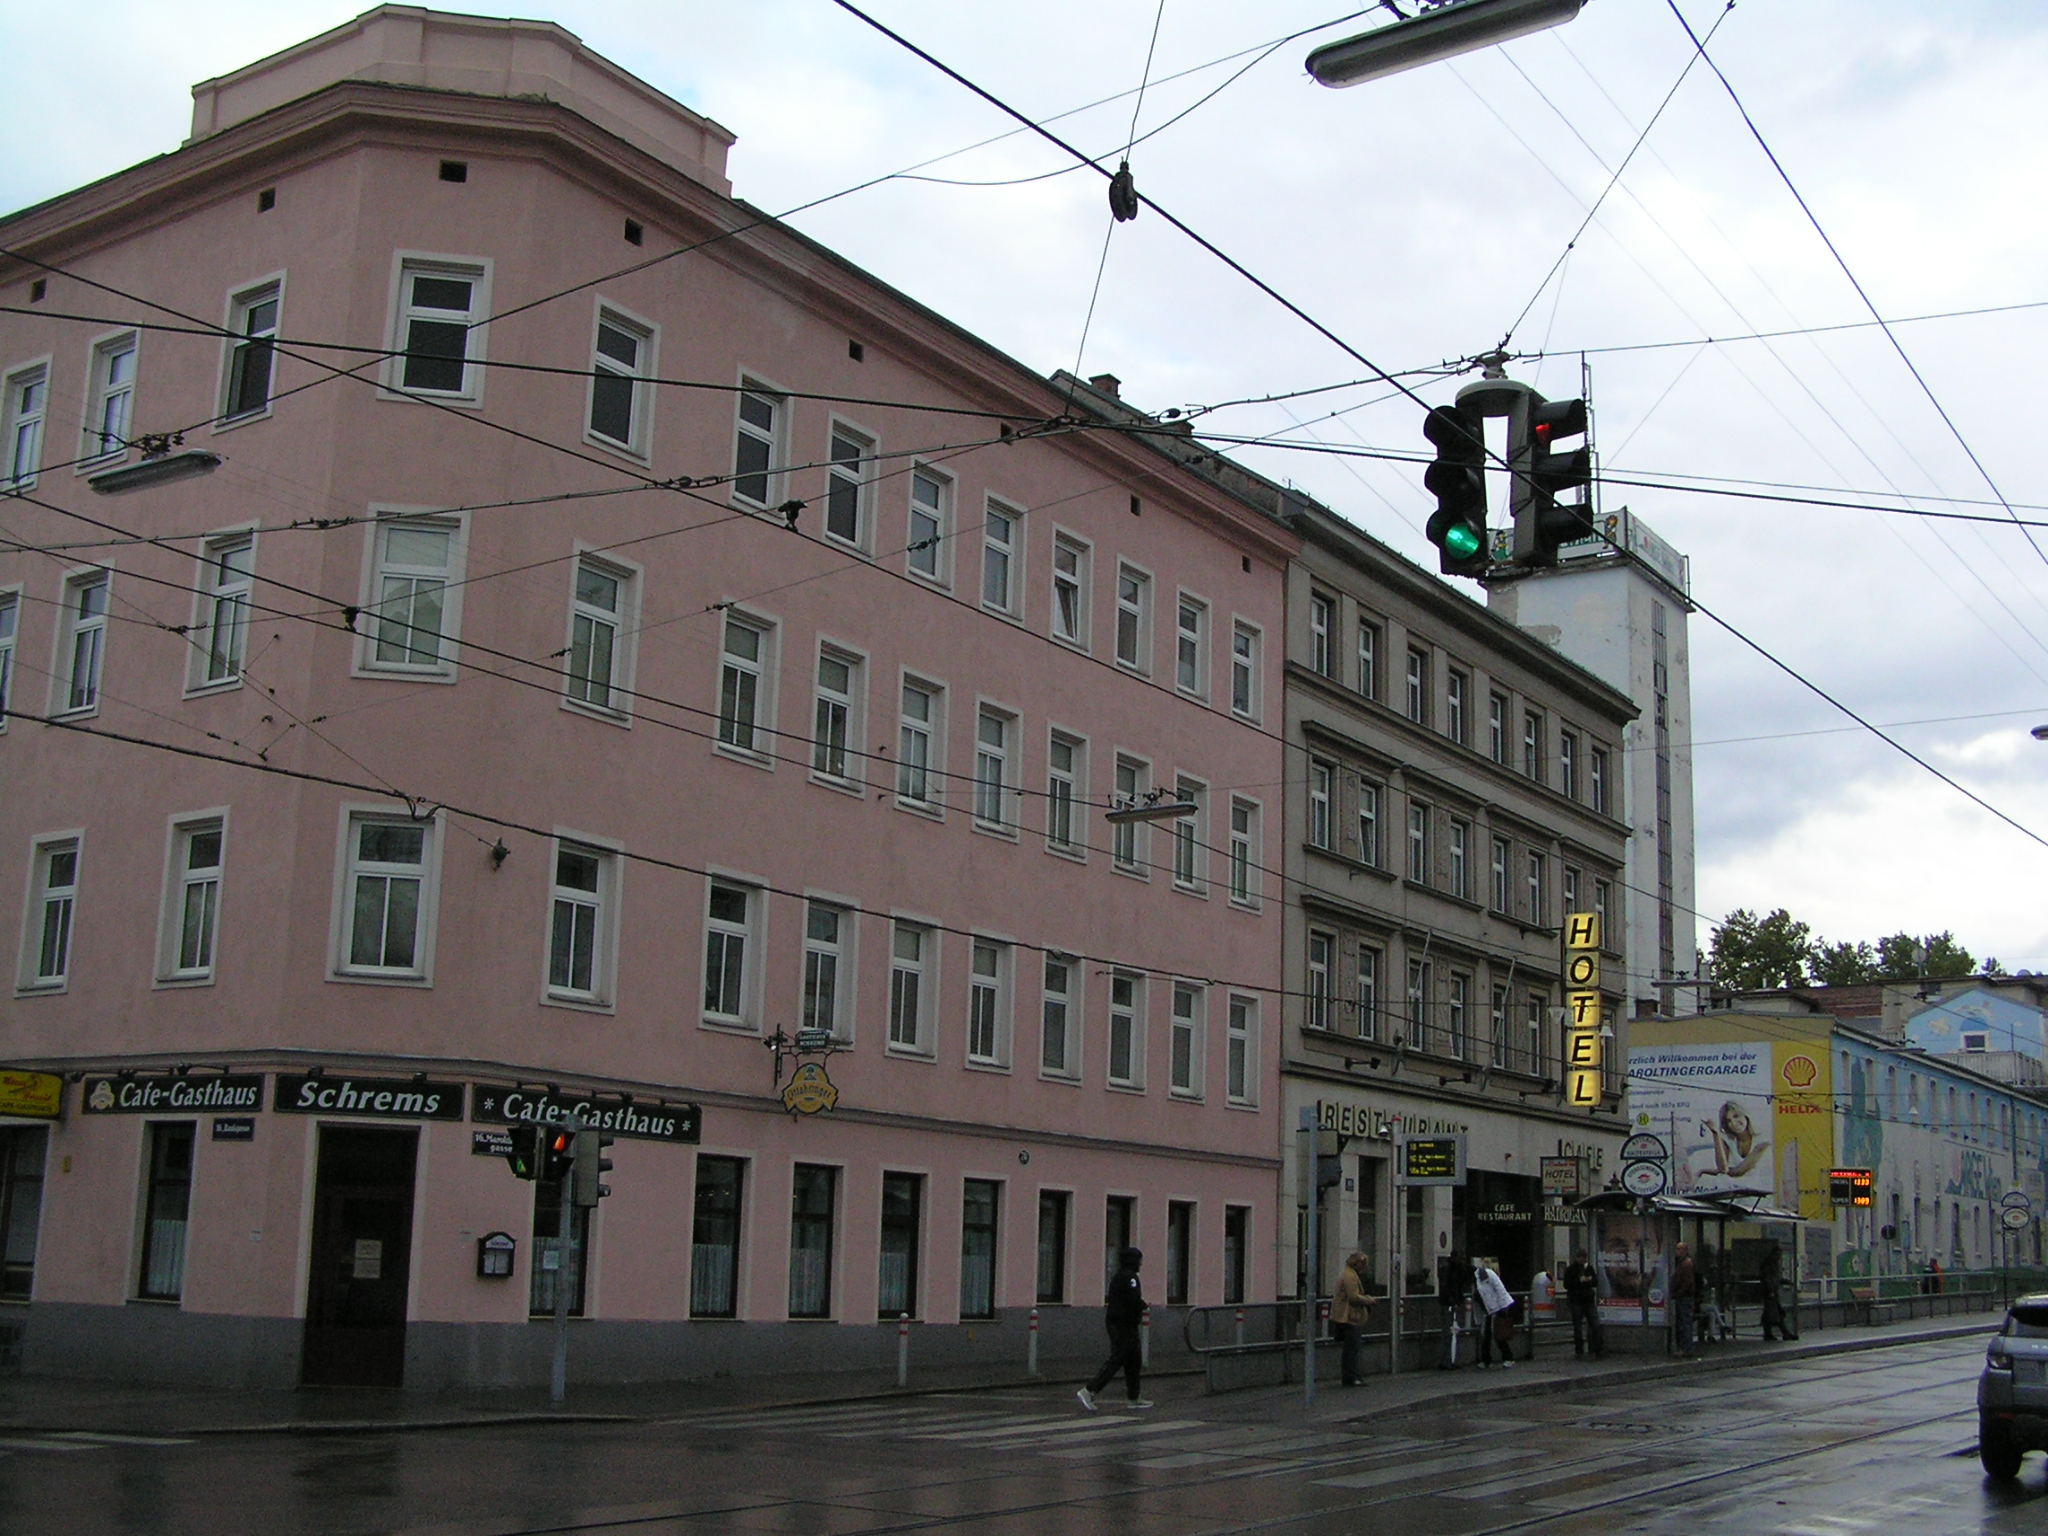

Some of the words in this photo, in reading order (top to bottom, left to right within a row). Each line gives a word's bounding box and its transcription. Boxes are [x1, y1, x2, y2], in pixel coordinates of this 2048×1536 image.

[1569, 916, 1594, 1102] HOTEL
[1658, 1052, 1719, 1063] Willkommen
[1722, 1052, 1737, 1061] bei
[1740, 1052, 1757, 1060] der
[1628, 1064, 1757, 1078] AROLTINGERGARAGE
[120, 1080, 257, 1107] Cafe-Gasthaus
[297, 1081, 441, 1113] Schrems
[503, 1094, 675, 1136] Cafe-Gasthaus
[1545, 1168, 1575, 1179] HOTEL
[1494, 1204, 1515, 1212] CAFE
[1477, 1212, 1532, 1221] RESTAURANT
